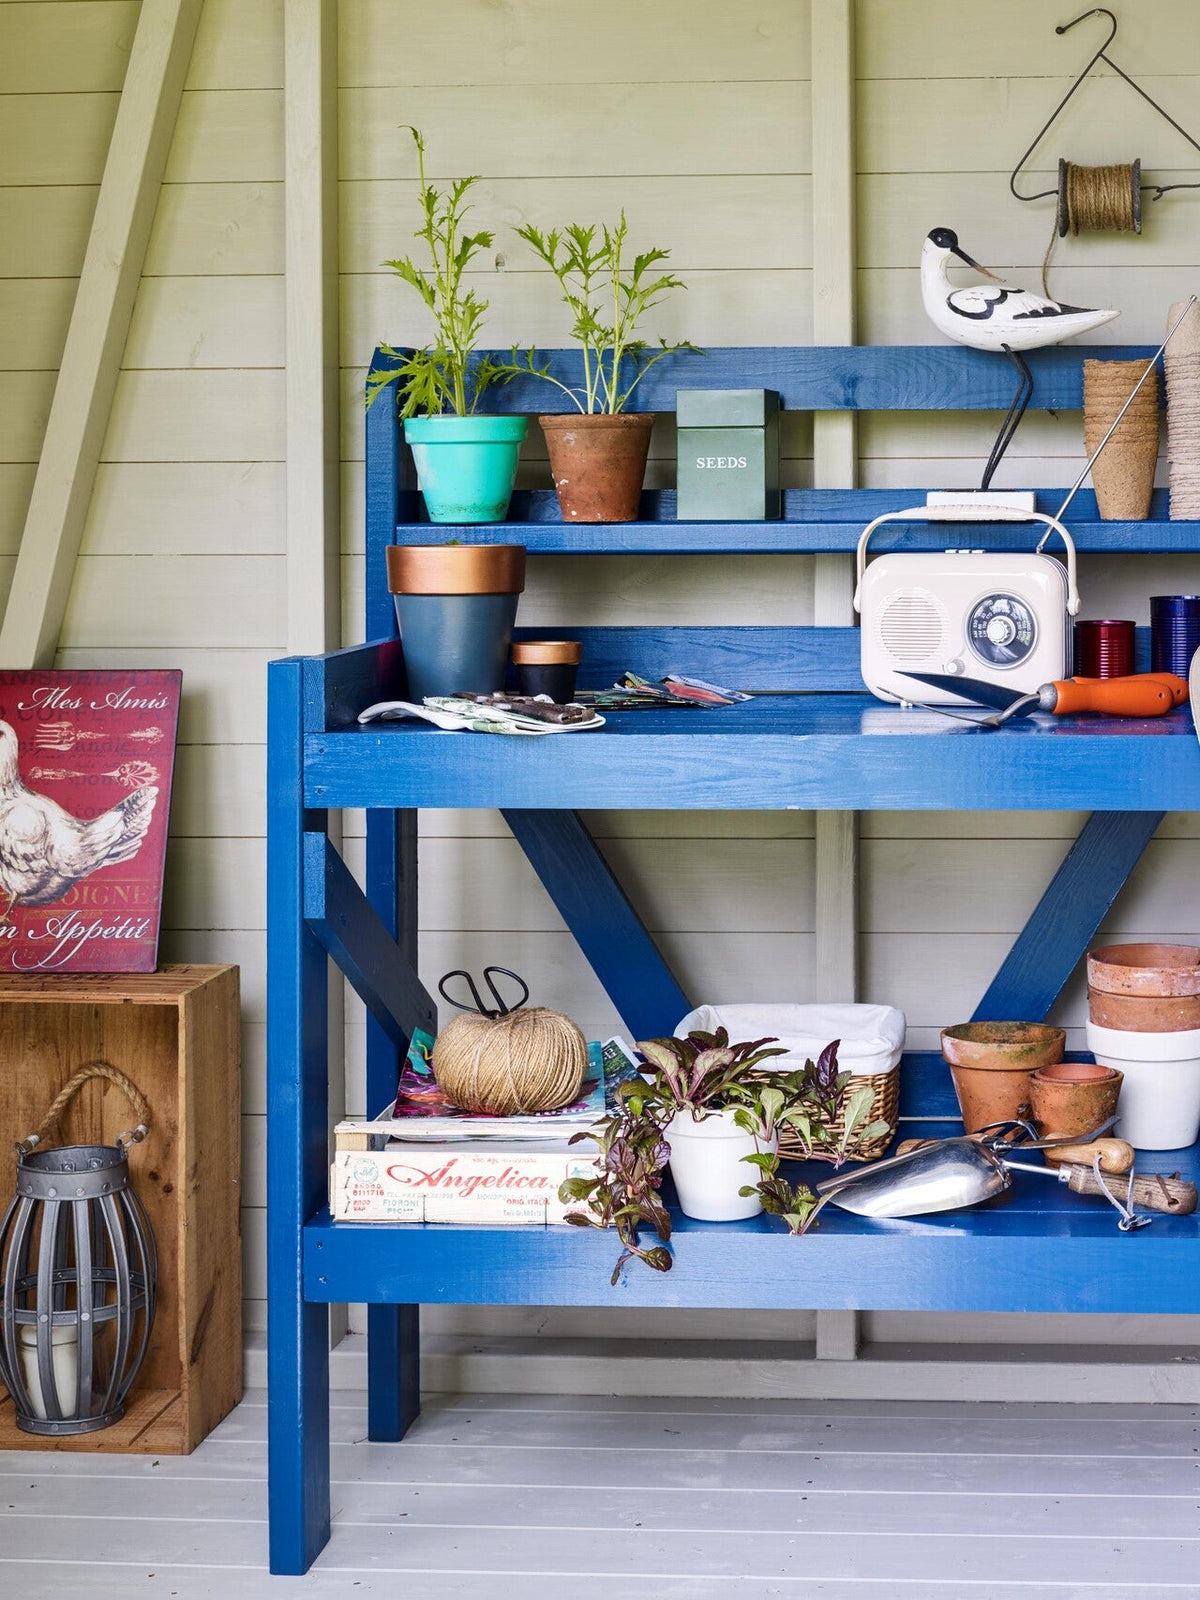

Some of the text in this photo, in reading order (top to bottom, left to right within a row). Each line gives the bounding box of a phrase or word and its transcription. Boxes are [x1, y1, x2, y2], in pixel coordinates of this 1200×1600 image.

[696, 457, 747, 469] SEEDS
[18, 685, 169, 710] Mes Amis
[12, 910, 151, 970] Appétit
[386, 1158, 549, 1198] Angelica
